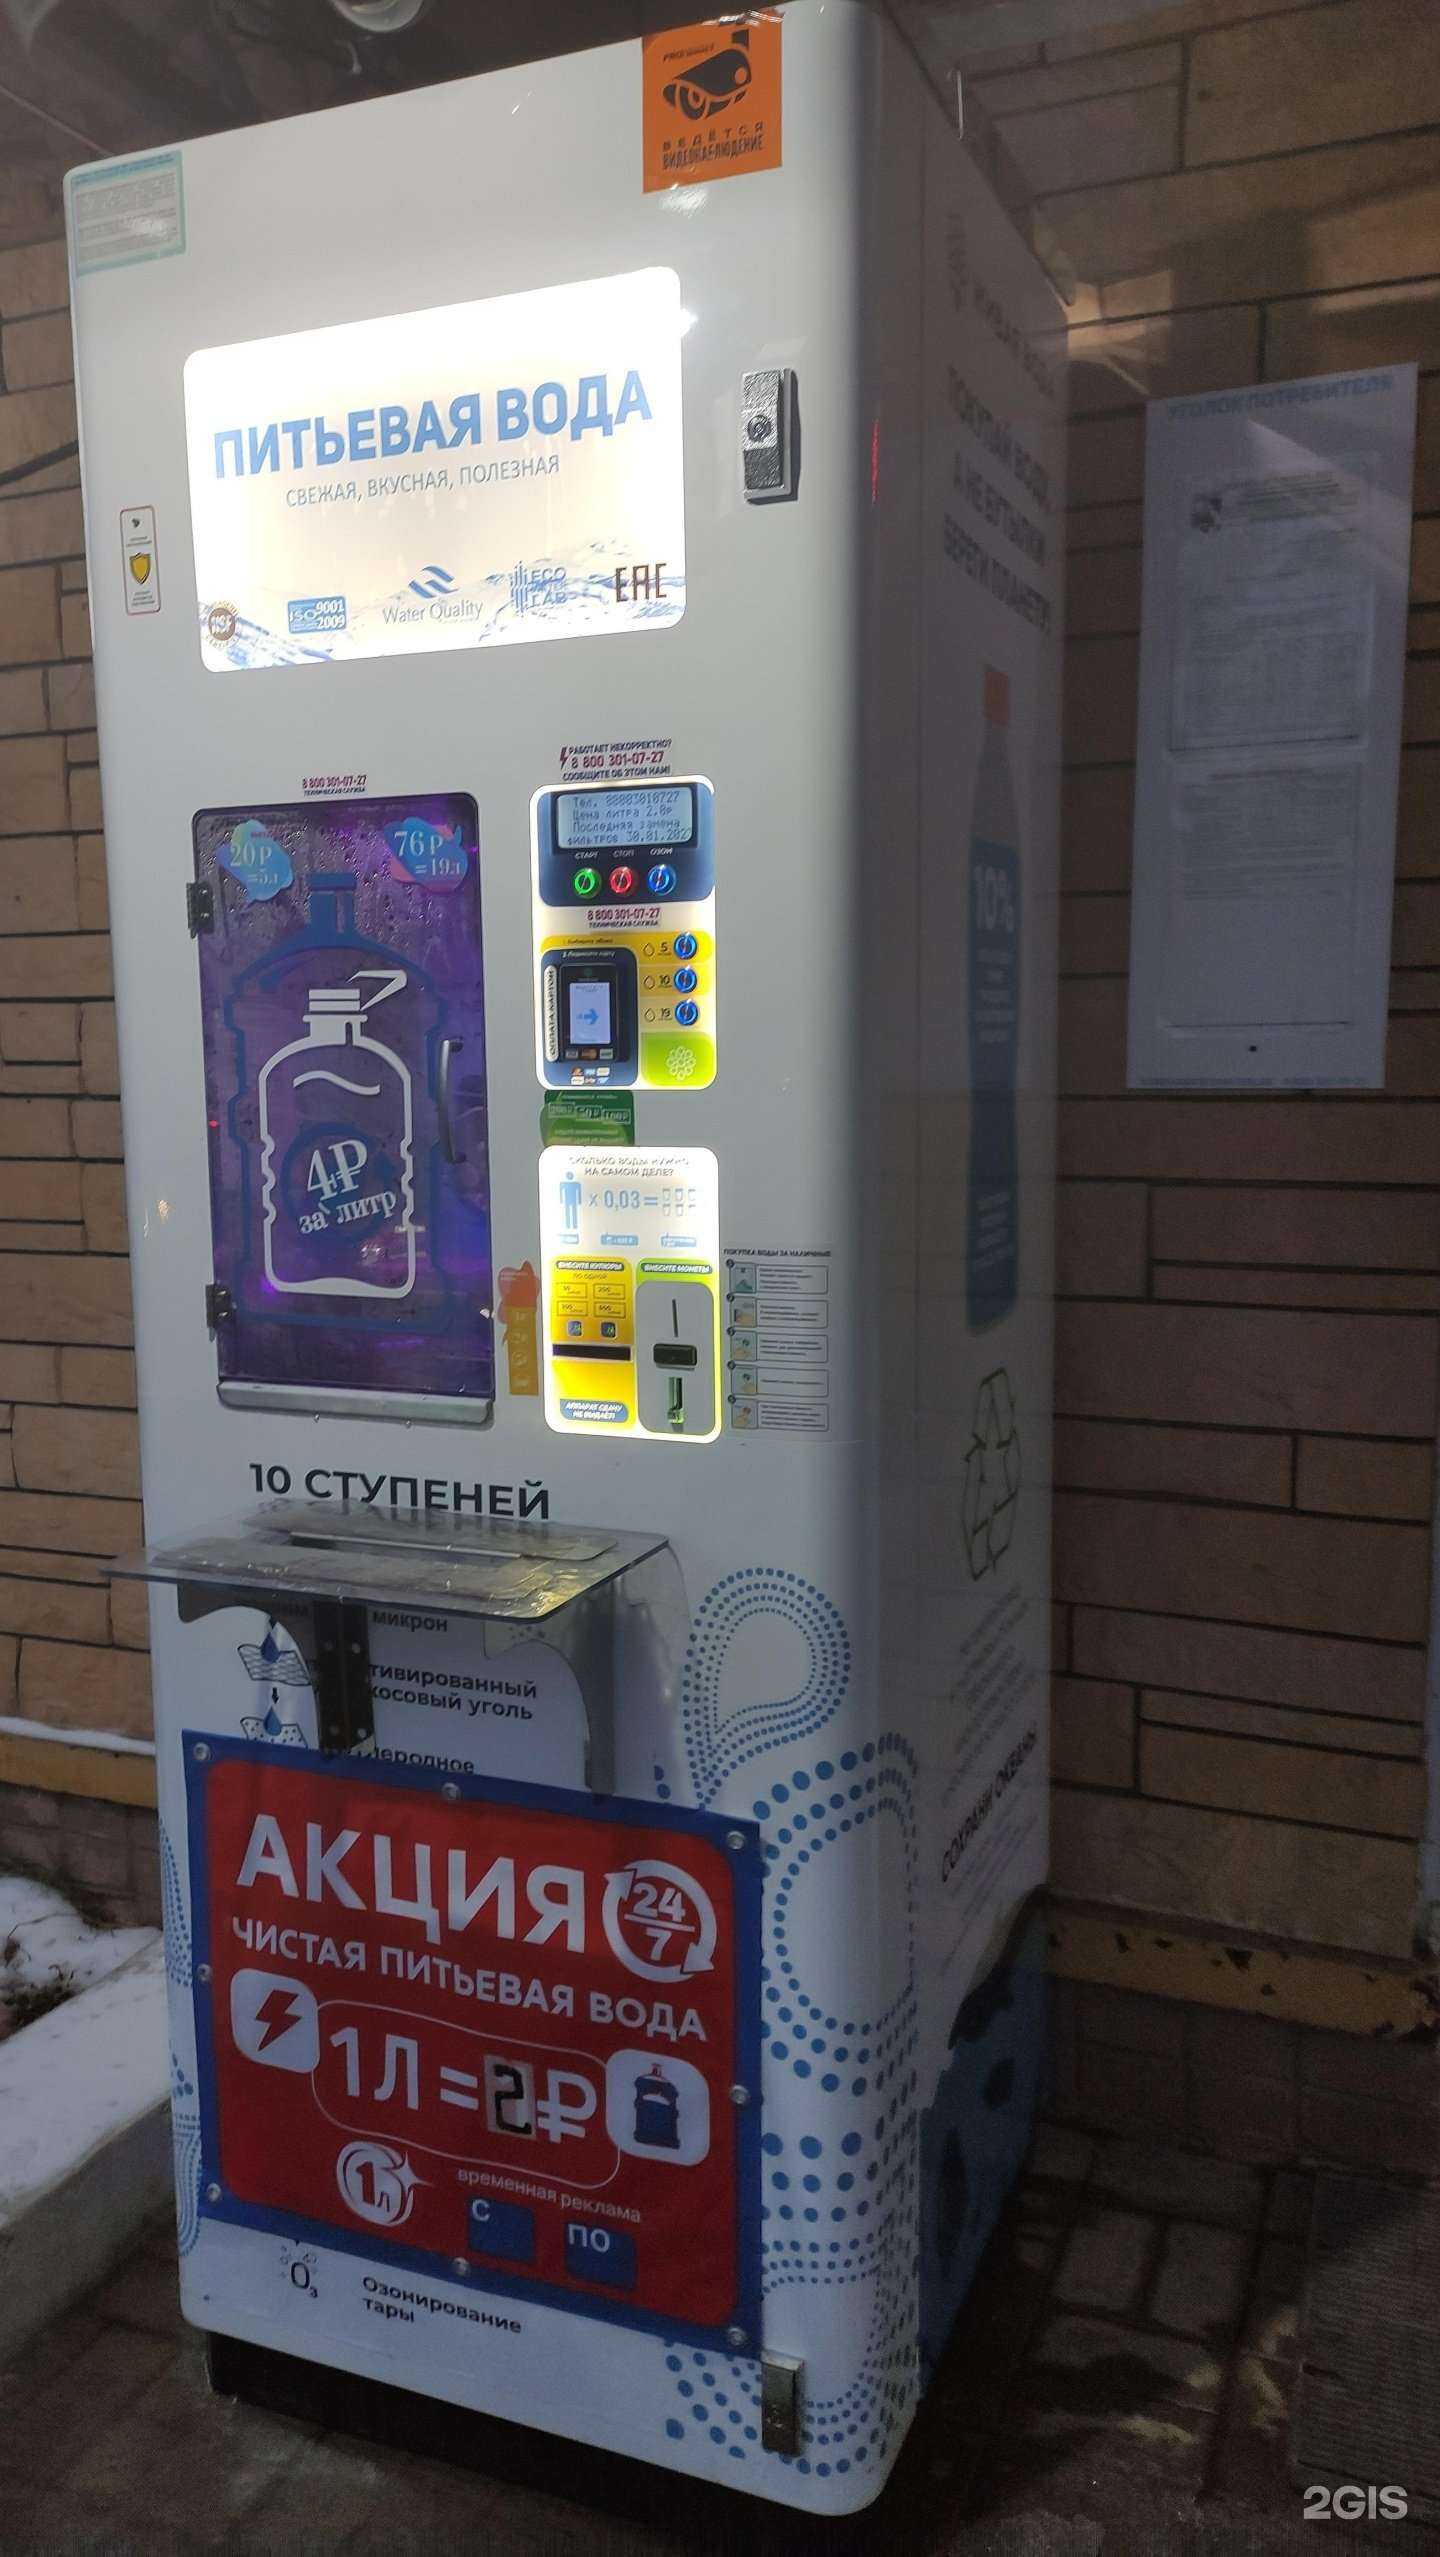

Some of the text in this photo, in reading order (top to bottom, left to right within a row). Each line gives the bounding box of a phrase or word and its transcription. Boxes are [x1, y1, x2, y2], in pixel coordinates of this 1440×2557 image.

[213, 369, 653, 480] ПИТЬЕВАЯ ВОДА
[285, 454, 560, 508] СВЕЖАЯ, ВКУСНАЯ, ПОЛЕЗНАЯ
[382, 600, 484, 625] Water Quality
[583, 755, 604, 769] 800
[608, 750, 665, 767] 301-07-27
[595, 908, 613, 920] 800
[614, 907, 661, 920] 301-07-27
[660, 941, 668, 952] 5
[659, 974, 671, 985] 10
[584, 1167, 599, 1177] НА
[600, 1167, 640, 1177] САМОМ
[299, 1191, 397, 1236] за литр
[603, 1189, 641, 1212] 0,03
[249, 1463, 550, 1520] 10 СТУПЕНЕЙ
[371, 1609, 449, 1633] микрон
[368, 1663, 538, 1699] тивированный
[369, 1684, 534, 1721] косовый уголь
[235, 1812, 587, 1955] АКЦИЯ
[633, 1880, 686, 1923] 24
[231, 1915, 708, 2043] ЧИСТАЯ ПИТЬЕВАЯ ВОДА
[457, 2167, 642, 2224] временная реклама
[567, 2223, 611, 2254] ПО
[362, 2274, 522, 2334] Озонирование
[362, 2297, 415, 2324] тары
